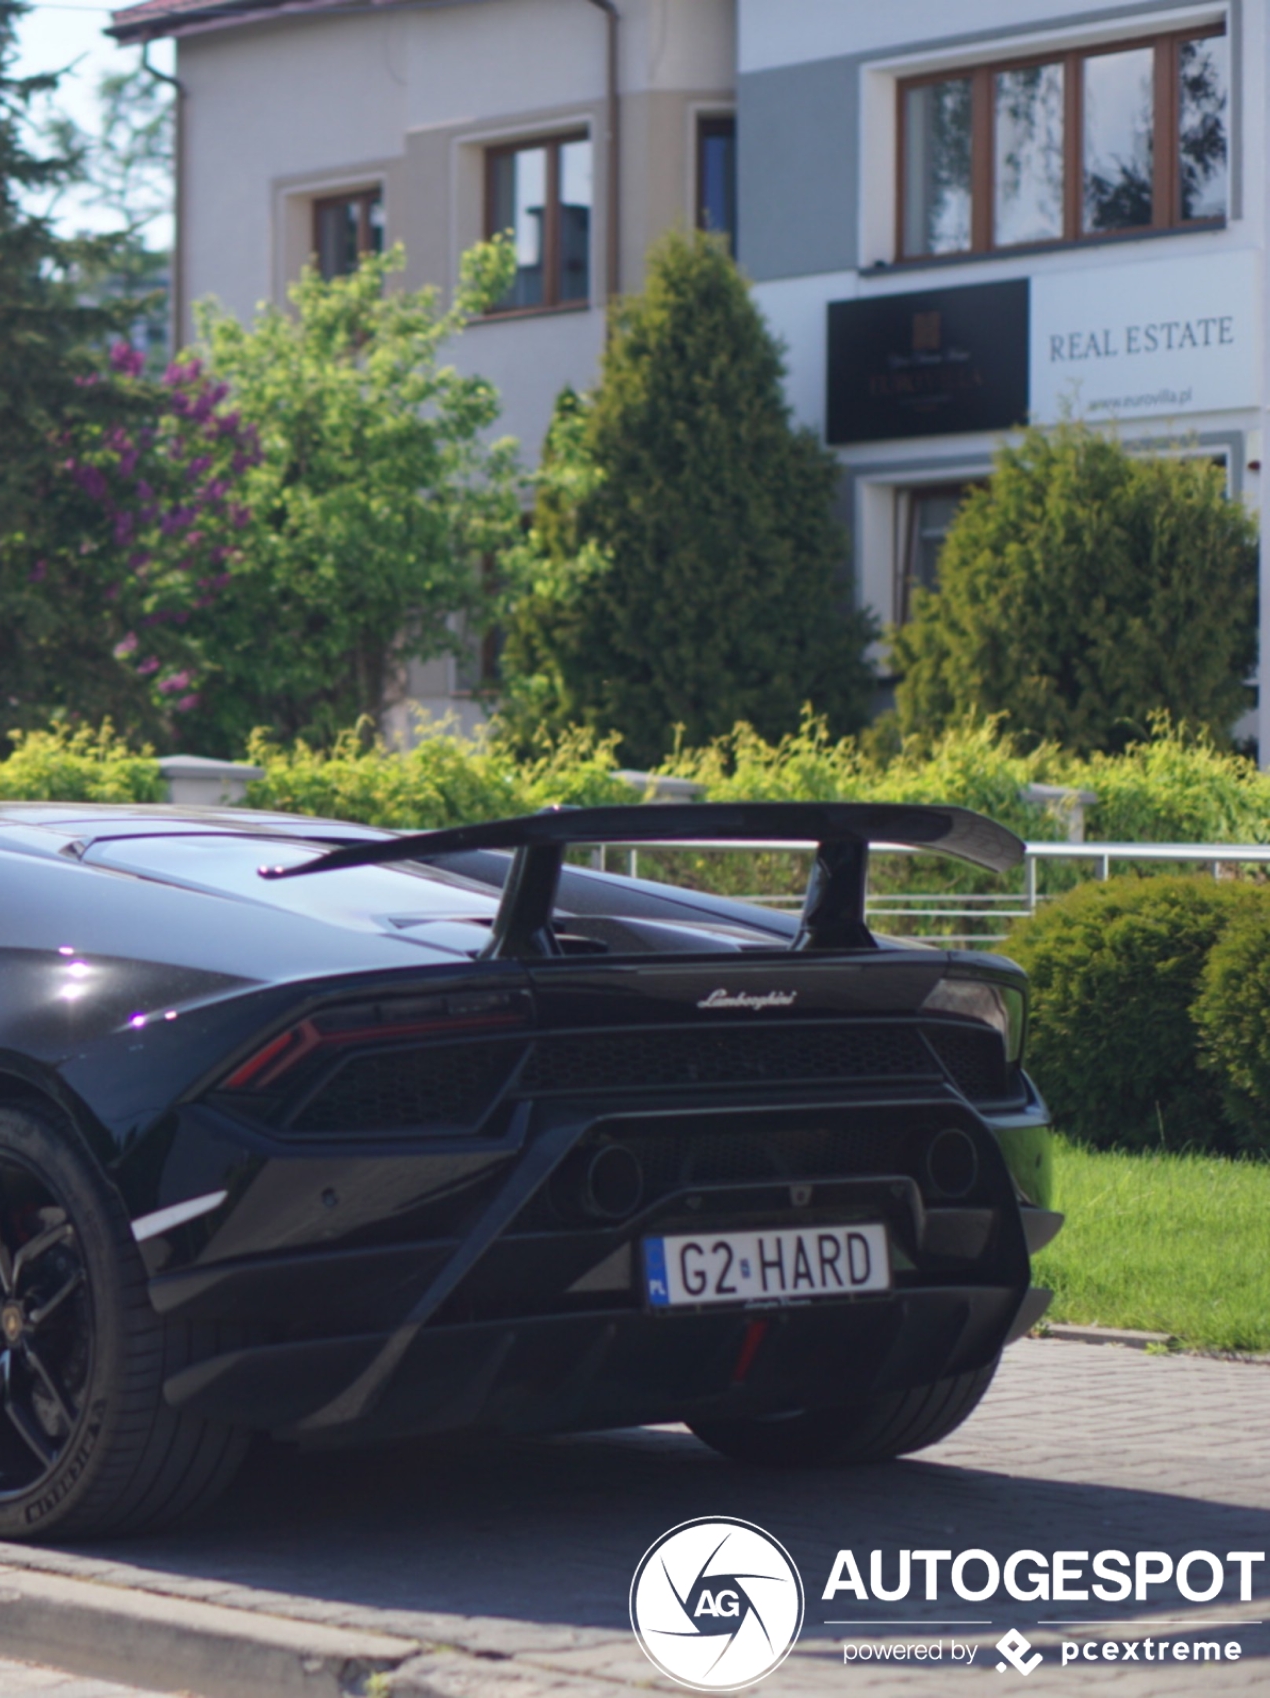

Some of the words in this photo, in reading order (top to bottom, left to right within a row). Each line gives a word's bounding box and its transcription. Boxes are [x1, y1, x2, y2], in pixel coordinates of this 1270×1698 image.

[1049, 329, 1118, 362] REAL
[1126, 316, 1234, 354] ESTATE
[697, 988, 797, 1011] Lamborghini
[680, 1241, 737, 1296] G2
[758, 1232, 871, 1291] HARD
